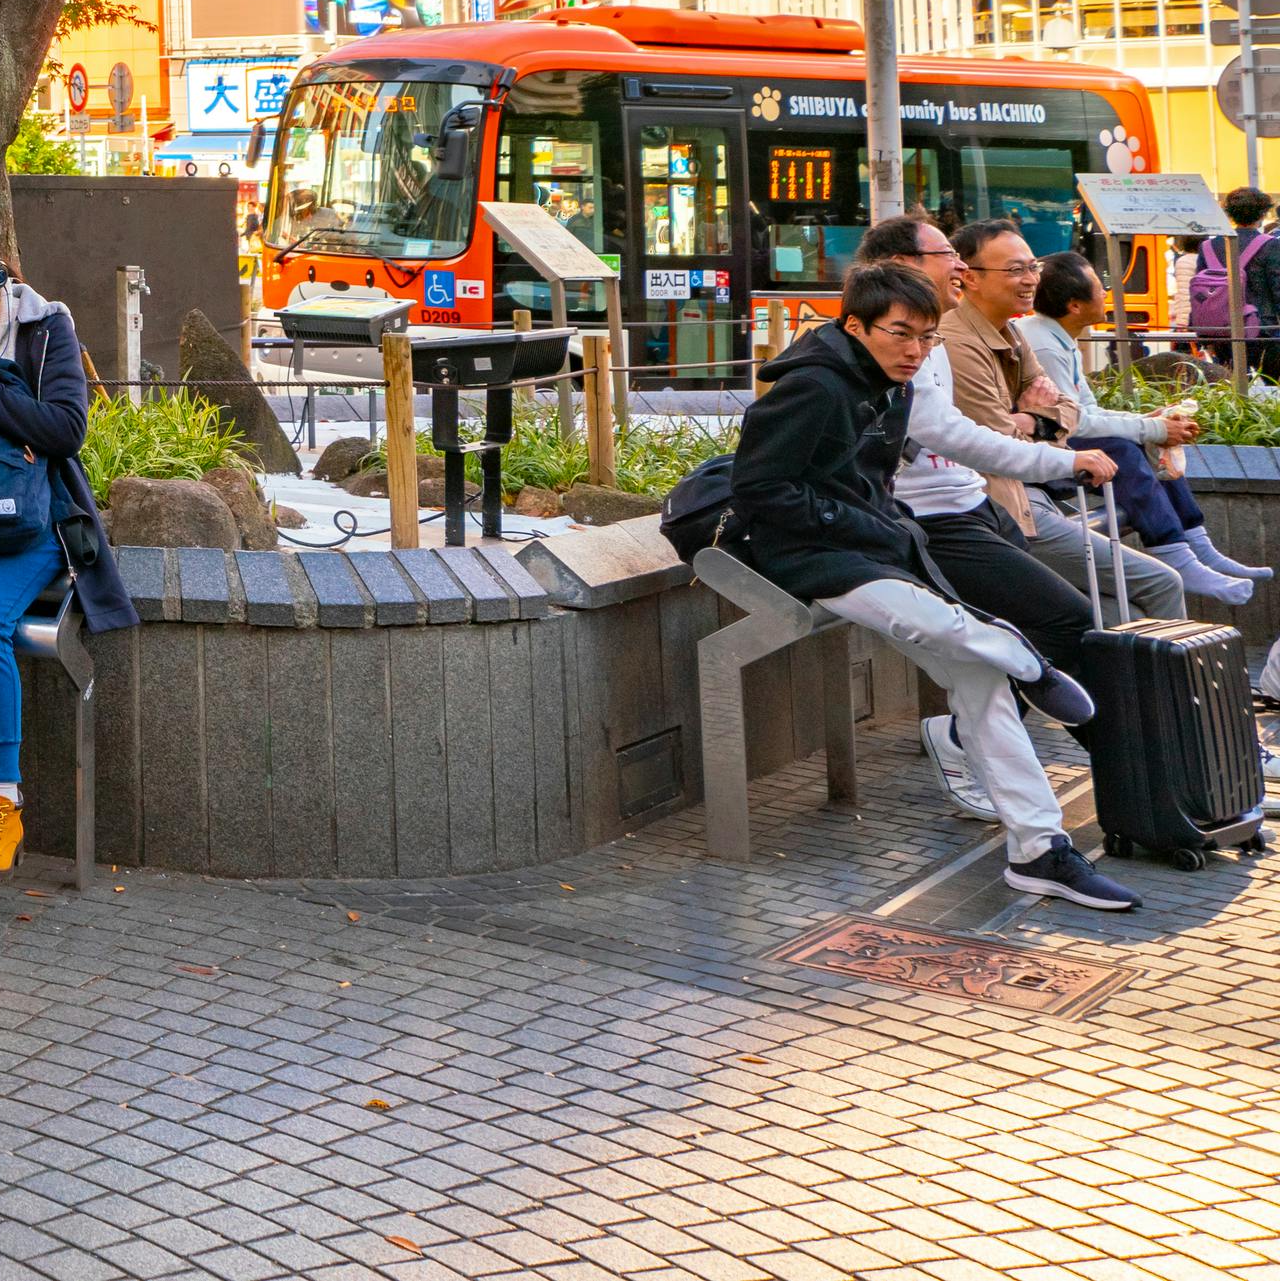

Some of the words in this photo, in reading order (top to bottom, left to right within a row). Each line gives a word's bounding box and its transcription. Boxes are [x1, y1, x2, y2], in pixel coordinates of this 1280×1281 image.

[789, 95, 858, 117] SHIBUYA
[861, 99, 945, 125] cmunity
[949, 101, 977, 121] bus
[981, 102, 1046, 124] HACHIKO
[650, 272, 686, 287] 出入口
[420, 309, 461, 325] D209
